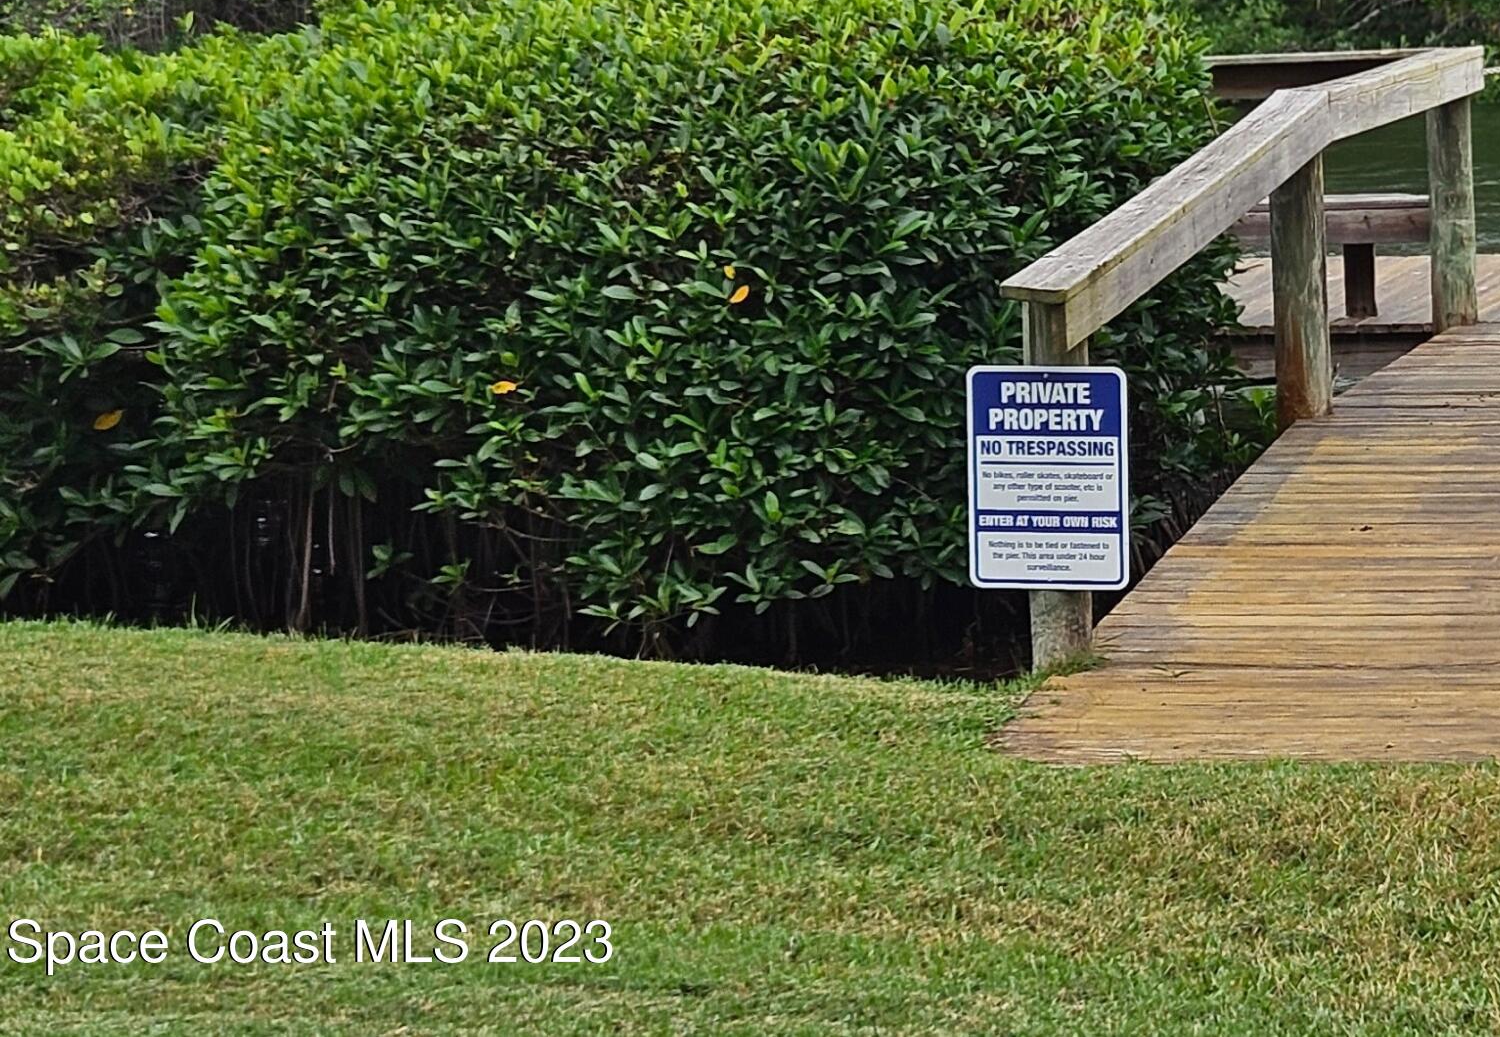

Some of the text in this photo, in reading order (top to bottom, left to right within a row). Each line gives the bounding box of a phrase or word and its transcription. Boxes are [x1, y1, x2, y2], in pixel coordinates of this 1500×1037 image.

[1001, 382, 1091, 404] PRIVATE
[989, 408, 1104, 431] PROPERTY
[981, 441, 1114, 456] NO TRESPASSING
[979, 515, 1117, 528] ENTER AT YOUR OWN RISK
[989, 541, 1015, 549] Nothing
